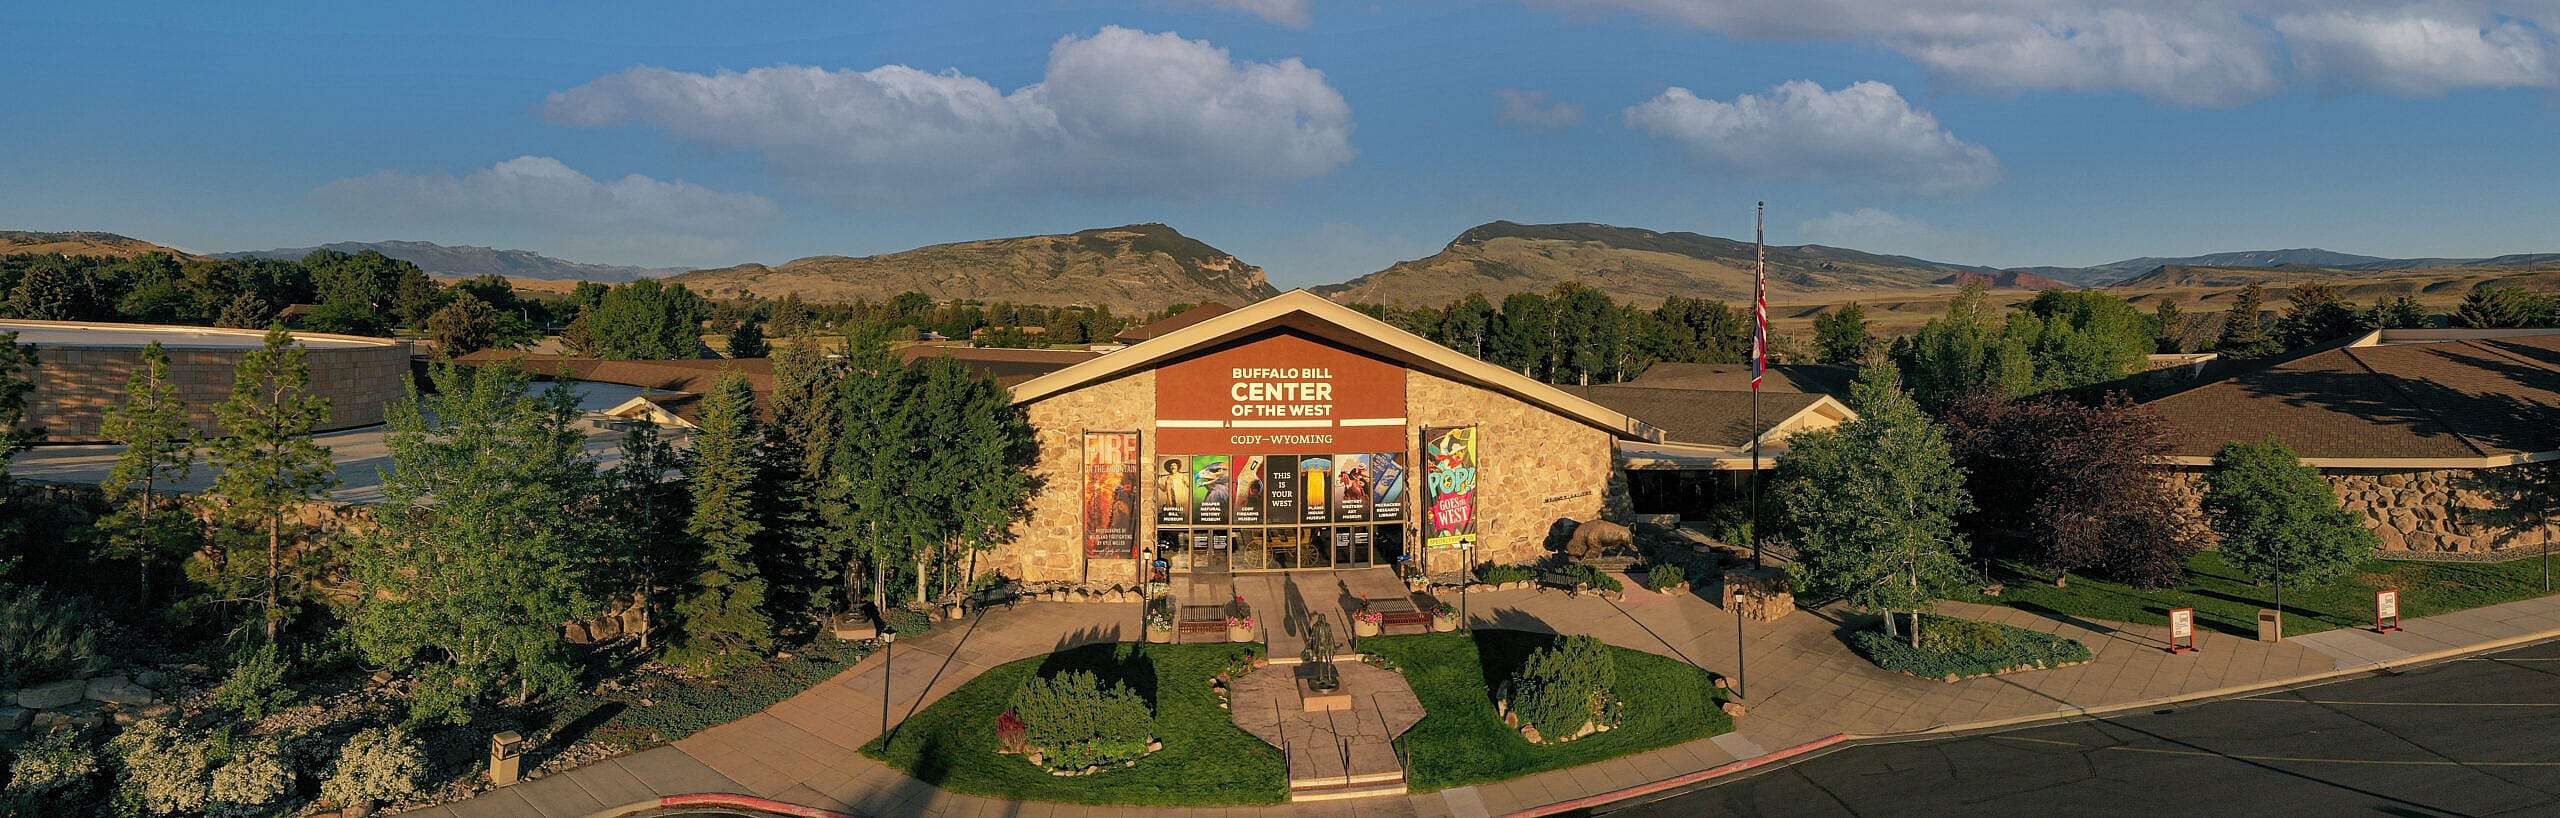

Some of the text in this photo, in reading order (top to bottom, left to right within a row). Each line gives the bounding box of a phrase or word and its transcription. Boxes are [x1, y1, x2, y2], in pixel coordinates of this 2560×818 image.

[1232, 368, 1333, 379] BUFFALO BILL
[1231, 382, 1333, 402] CENTER
[1231, 404, 1333, 417] OF THE WEST
[1085, 433, 1137, 465] FIRE
[1094, 464, 1105, 473] THE
[1106, 464, 1137, 473] MOUNTAIN
[1273, 472, 1291, 480] THIS
[1428, 467, 1475, 498] POP!
[1272, 490, 1293, 498] YOUR
[1440, 497, 1460, 511] GOES
[1438, 505, 1469, 526] WEST
